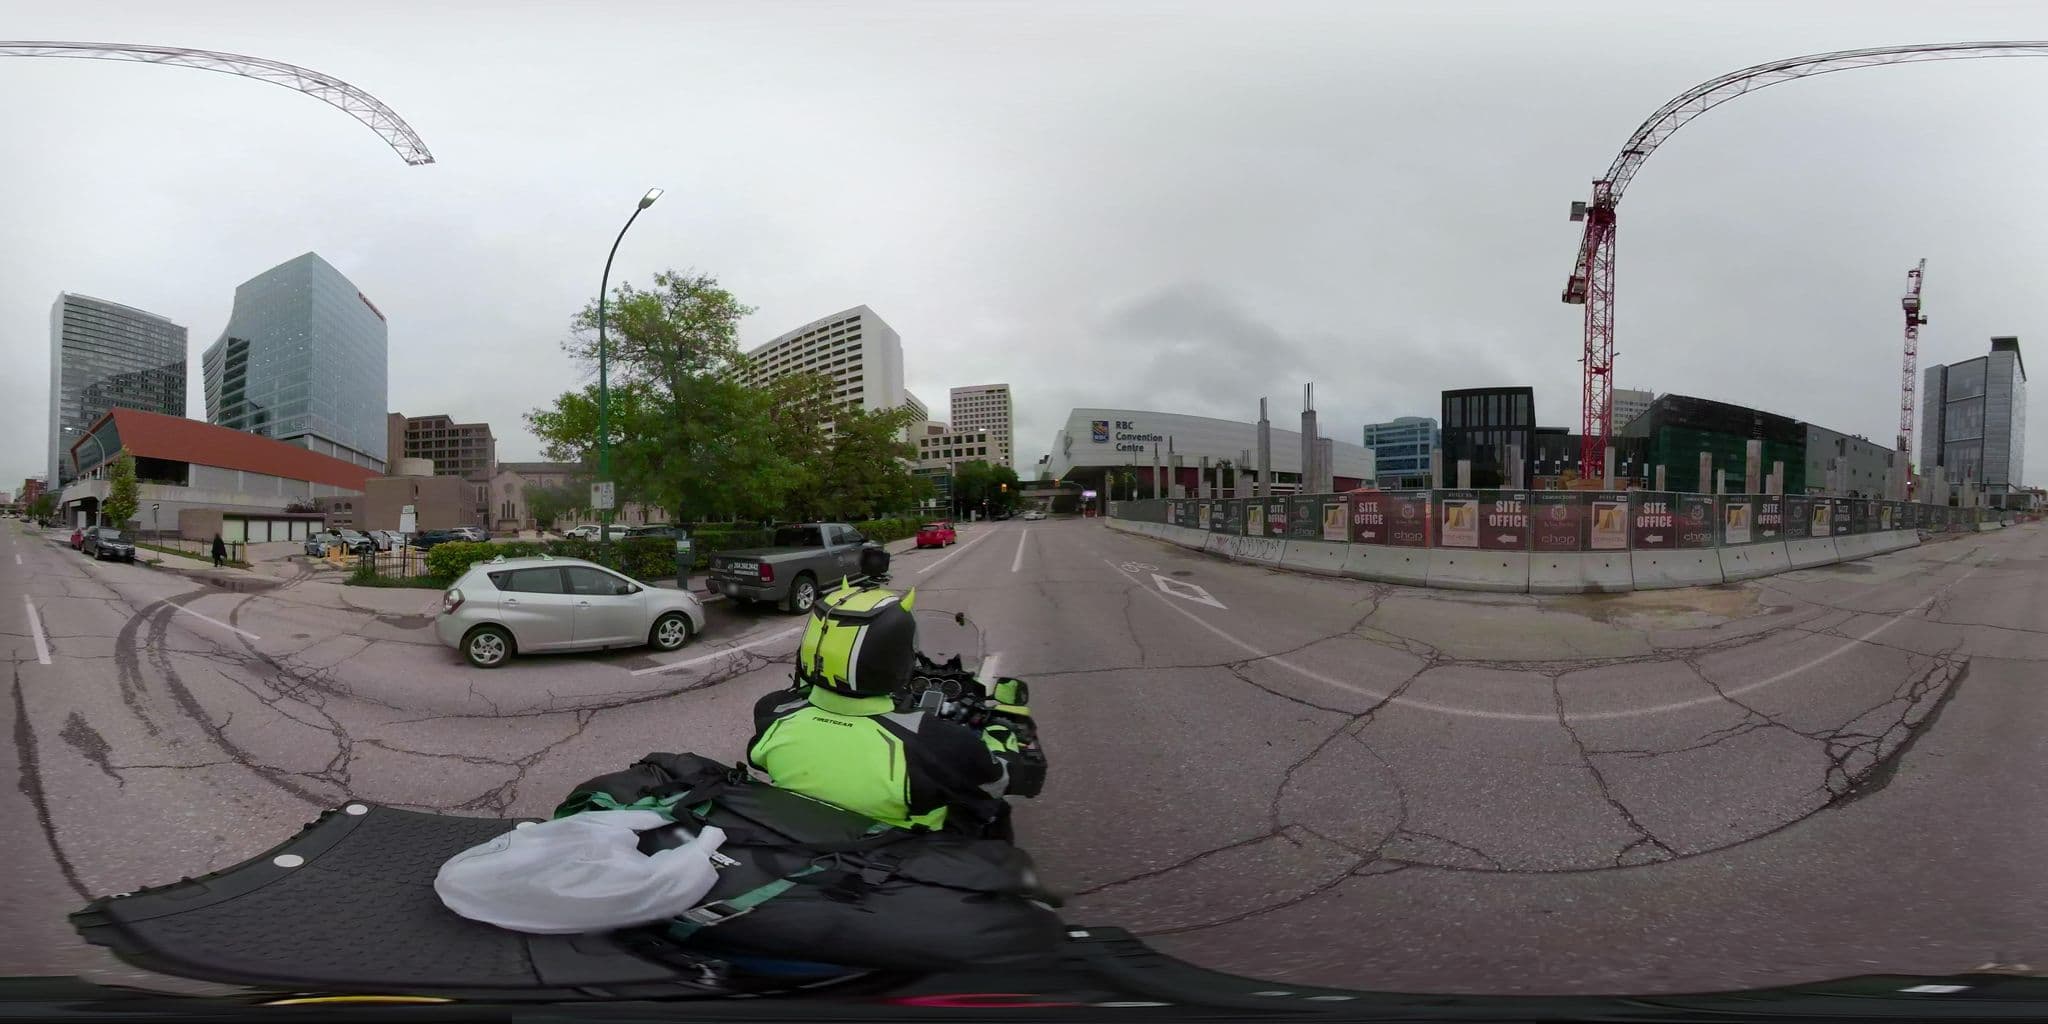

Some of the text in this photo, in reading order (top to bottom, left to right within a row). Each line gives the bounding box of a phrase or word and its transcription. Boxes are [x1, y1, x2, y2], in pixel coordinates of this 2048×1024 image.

[1115, 420, 1134, 430] RBC
[1115, 431, 1163, 442] Convention
[1115, 442, 1145, 452] Centre
[1270, 504, 1284, 514] SITE
[1358, 501, 1378, 513] SITE
[1495, 500, 1522, 513] SITE
[1643, 502, 1667, 514] SITE
[1762, 503, 1779, 513] SITE
[1354, 514, 1384, 525] OFFICE
[1488, 514, 1529, 527] OFFICE
[1636, 515, 1672, 528] OFFICE
[1757, 514, 1782, 525] OFFICE
[1393, 529, 1423, 540] chop
[1541, 532, 1576, 545] chop
[812, 716, 854, 728] FIRSTGEAR
